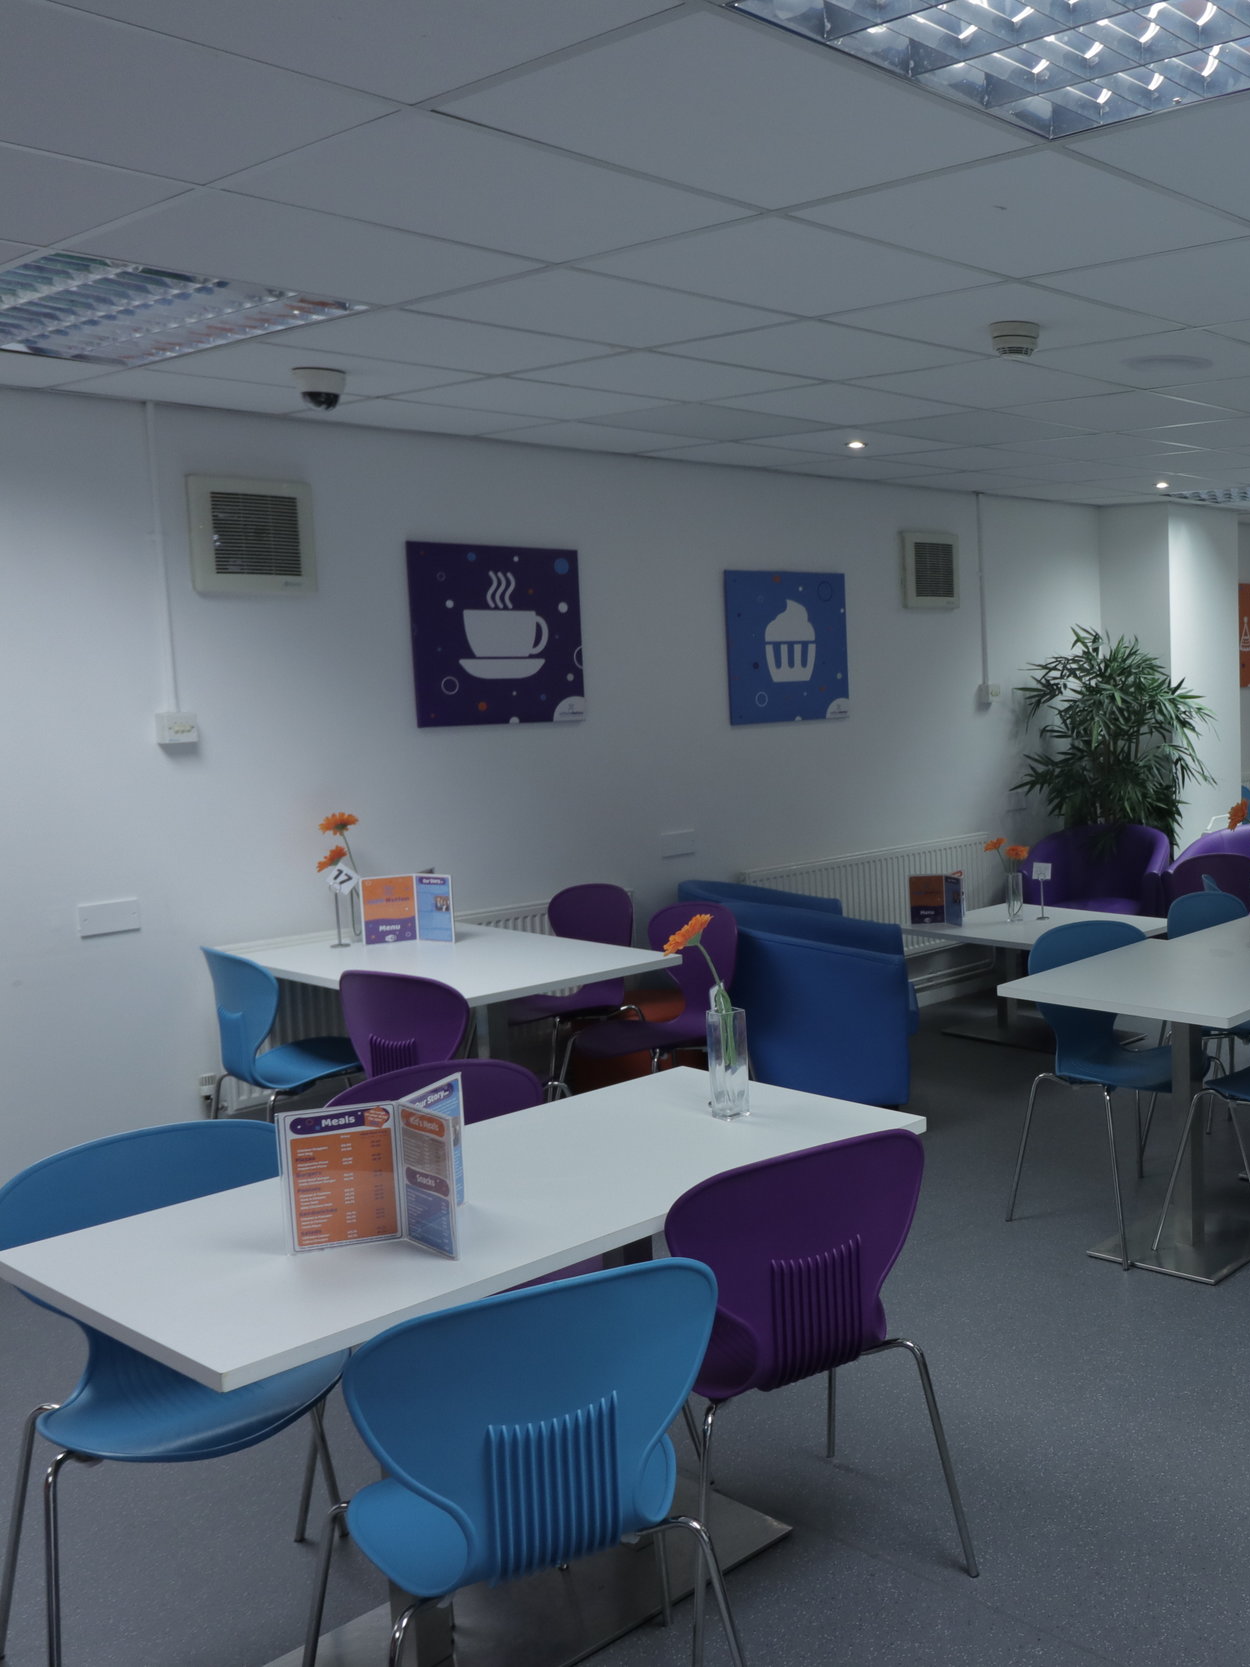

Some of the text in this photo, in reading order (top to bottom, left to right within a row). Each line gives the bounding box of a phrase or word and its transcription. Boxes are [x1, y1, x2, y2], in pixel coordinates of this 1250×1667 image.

[333, 868, 353, 885] 17
[379, 924, 401, 933] Menu
[321, 1115, 356, 1128] Meals
